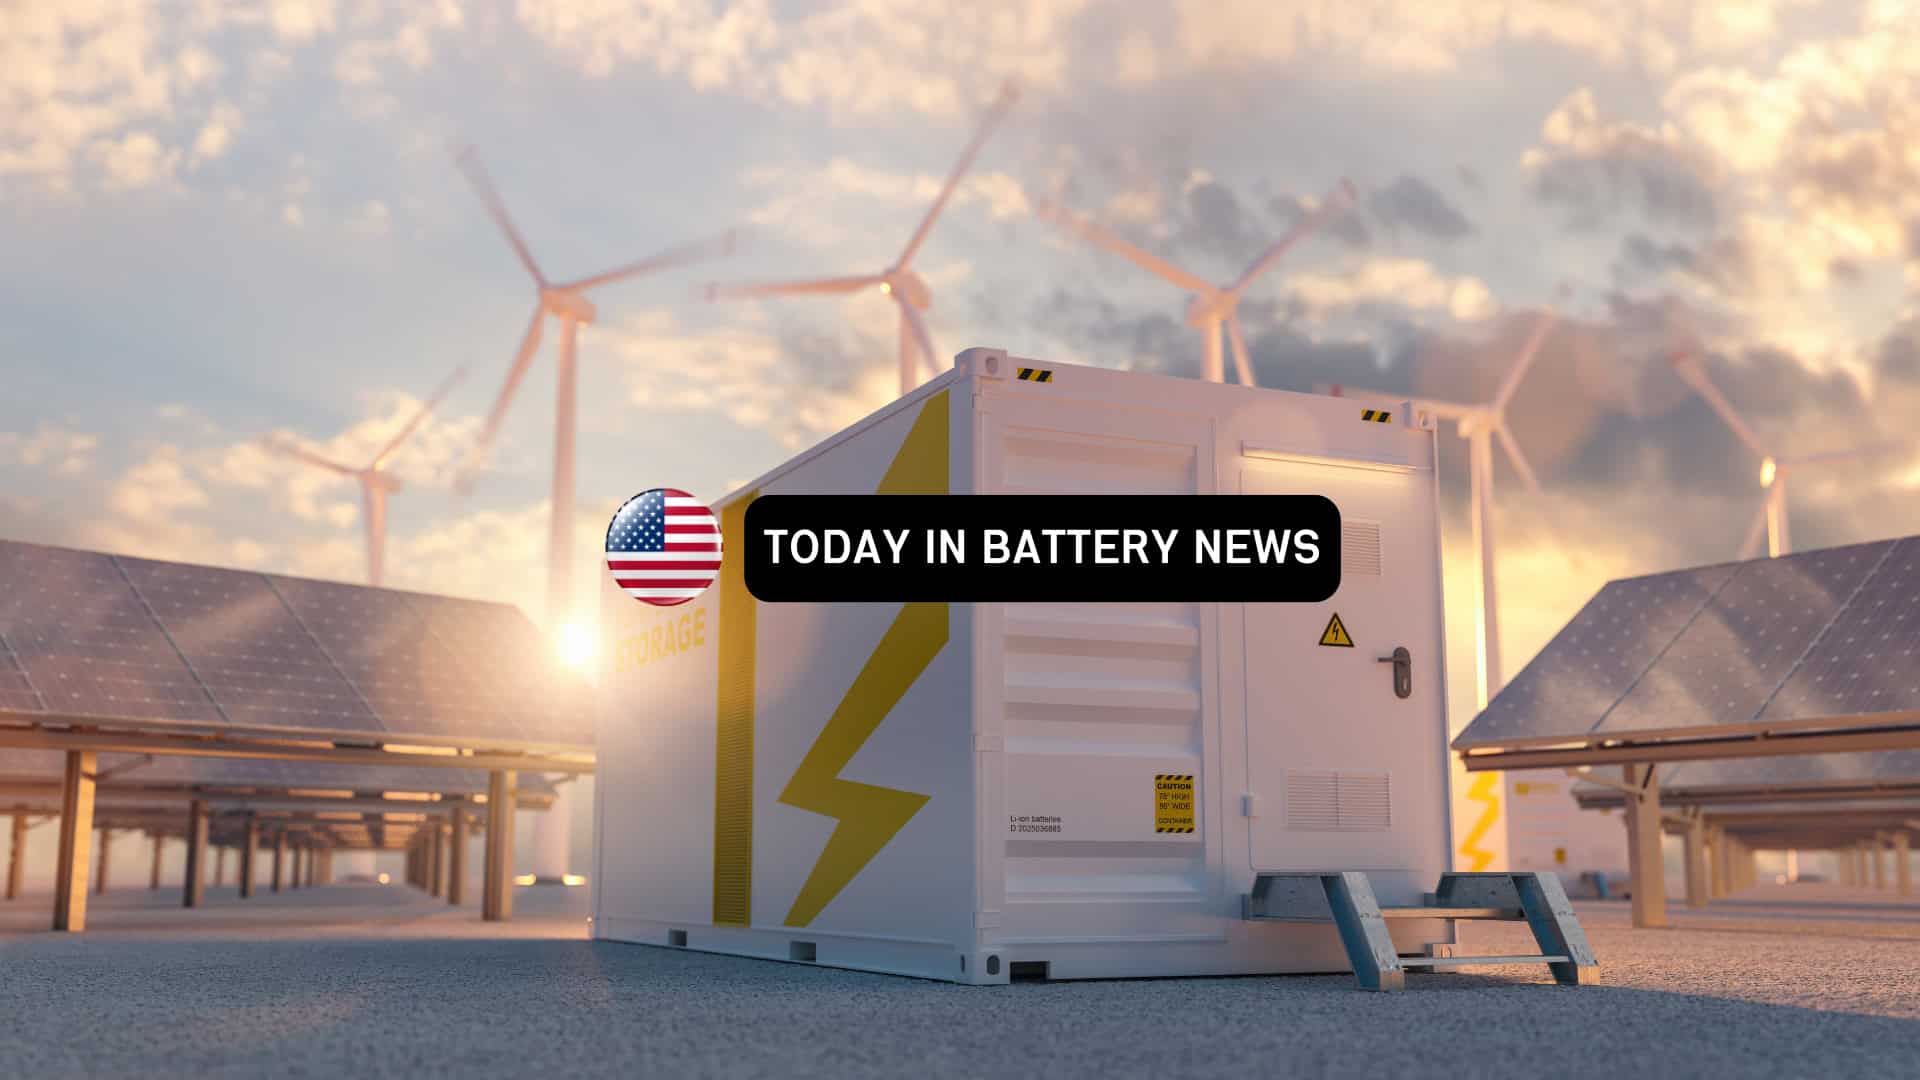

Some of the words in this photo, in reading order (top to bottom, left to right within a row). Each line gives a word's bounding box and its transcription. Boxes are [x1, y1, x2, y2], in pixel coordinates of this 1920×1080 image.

[615, 606, 705, 672] STORAGE
[1171, 802, 1192, 810] WIDE
[1010, 815, 1030, 823] Li-ion
[1031, 815, 1062, 823] batteries
[1010, 824, 1017, 832] D
